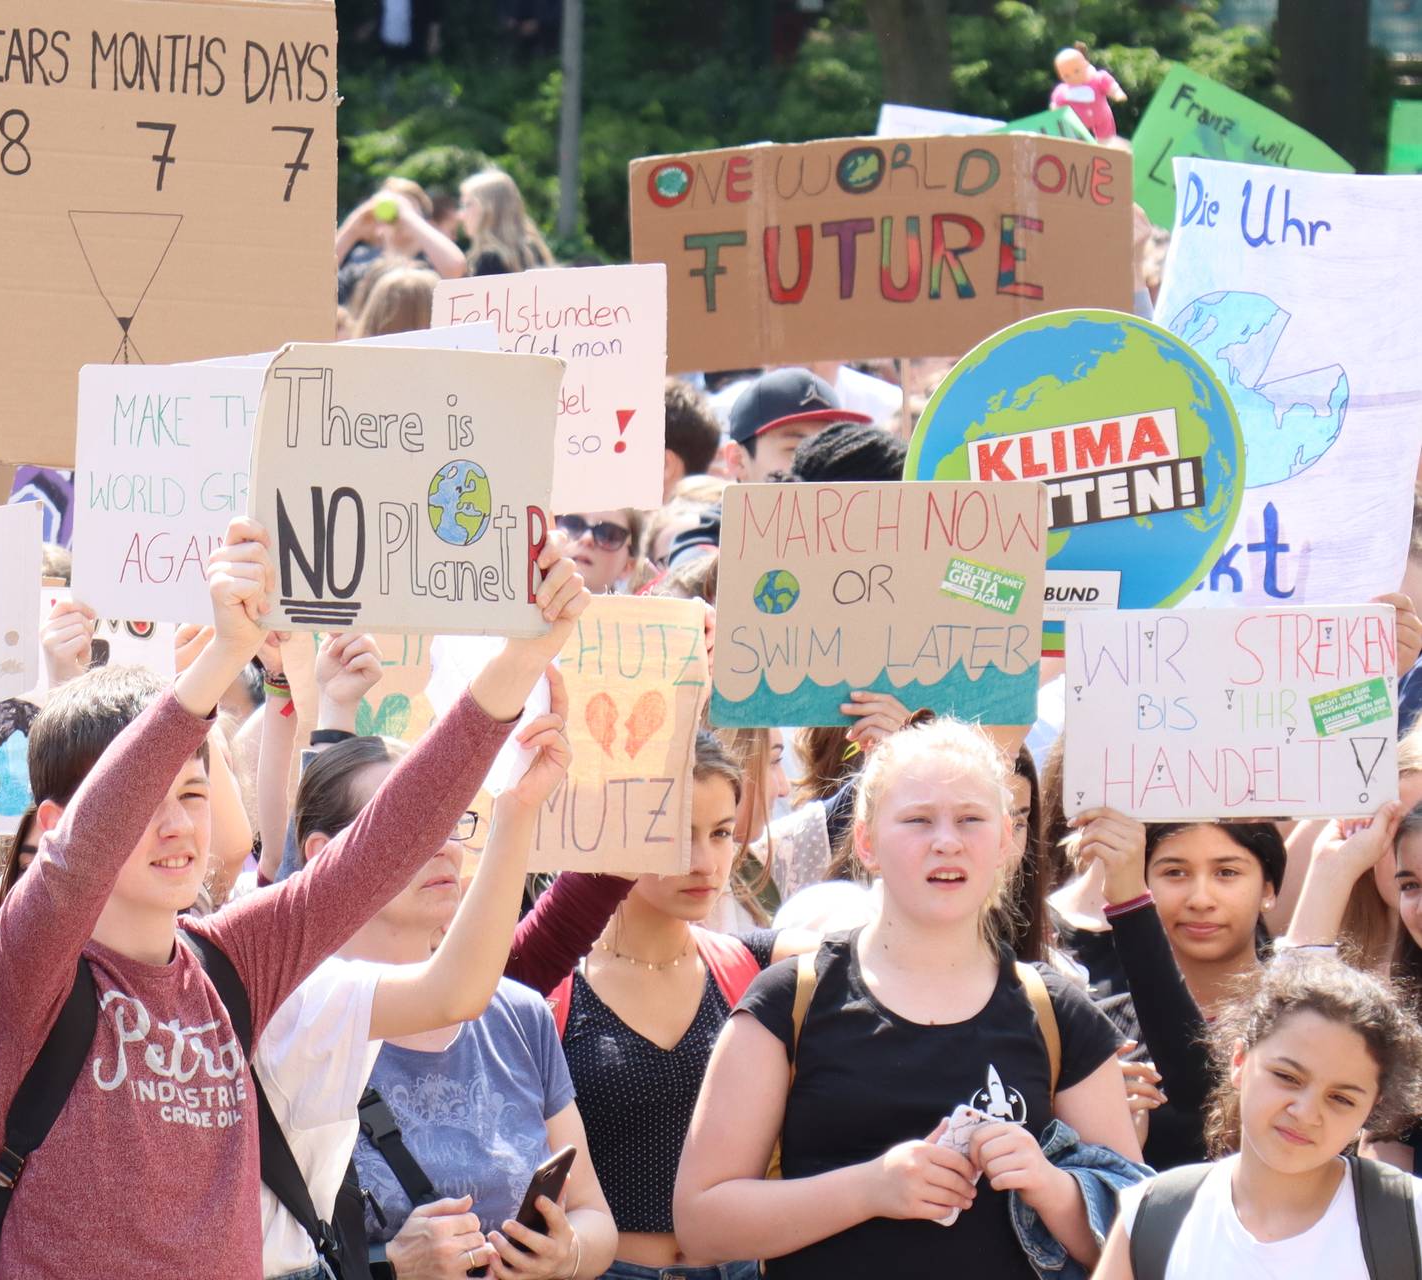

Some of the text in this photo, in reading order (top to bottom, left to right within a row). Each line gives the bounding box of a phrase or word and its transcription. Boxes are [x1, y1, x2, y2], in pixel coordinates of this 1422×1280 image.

[90, 33, 227, 97] MONTHS
[243, 40, 329, 104] DAYS
[135, 121, 178, 193] 7
[270, 126, 316, 203] 7
[646, 141, 1115, 209] ONE WORLD ONE
[1179, 171, 1333, 249] Die Uhr
[683, 213, 1046, 314] FUTURE
[571, 338, 623, 358] man
[113, 393, 192, 448] MAKE
[273, 367, 476, 453] There is
[566, 434, 603, 456] so
[976, 415, 1172, 483] KLIMA
[89, 471, 186, 518] WORLD
[738, 487, 1045, 560] MARCH NOW
[275, 486, 366, 600] NO
[379, 504, 518, 602] Planet
[831, 564, 896, 605] OR
[948, 568, 999, 597] GRETA
[973, 591, 1015, 611] AGAIN!
[1043, 586, 1100, 602] BUND
[730, 624, 1031, 674] SWIM LATER
[1079, 613, 1396, 688] WIR STREIKEN
[1137, 688, 1299, 732] BIS IHR
[1104, 739, 1337, 810] HANDELT
